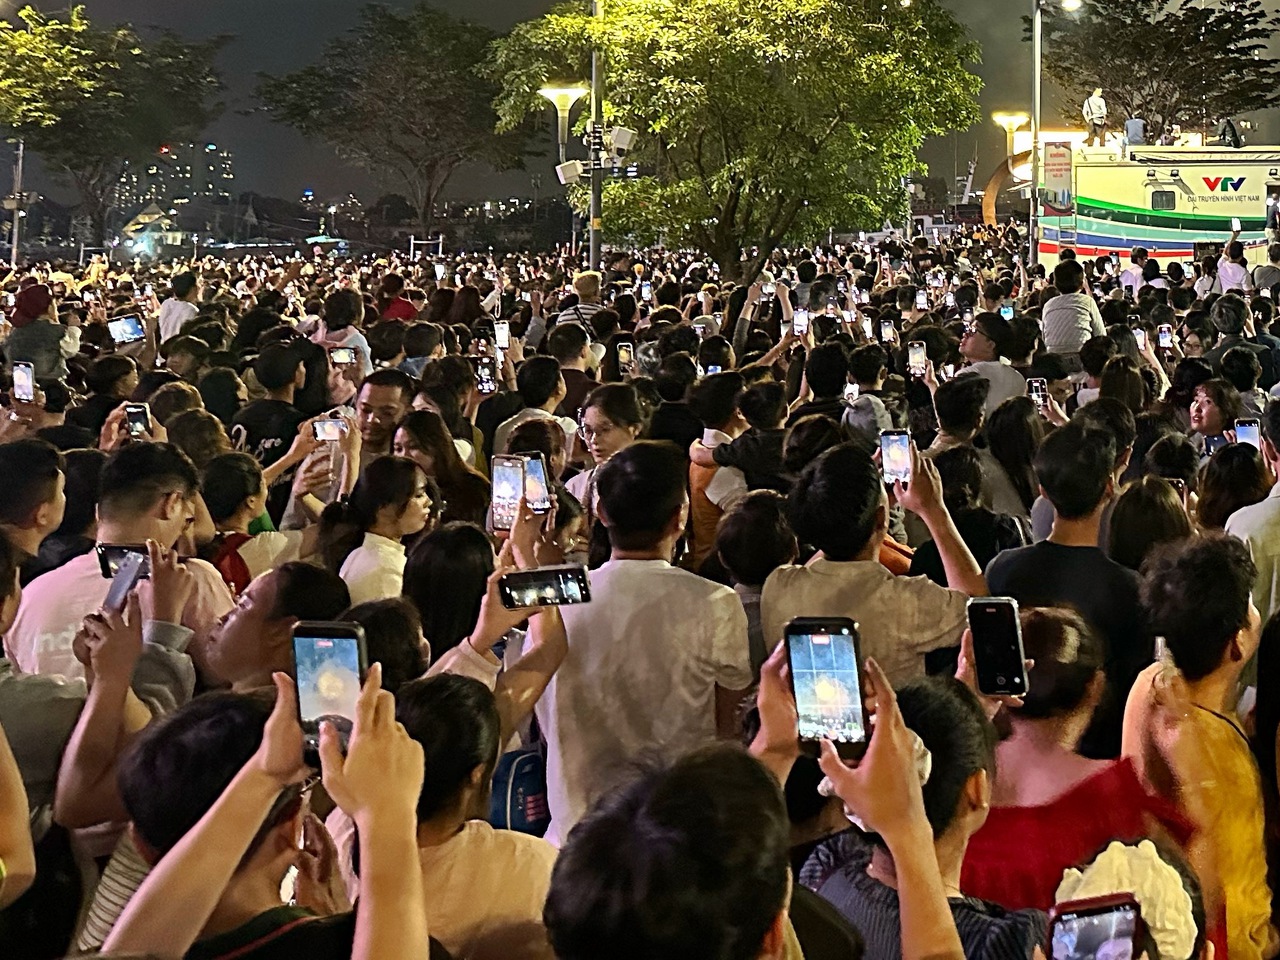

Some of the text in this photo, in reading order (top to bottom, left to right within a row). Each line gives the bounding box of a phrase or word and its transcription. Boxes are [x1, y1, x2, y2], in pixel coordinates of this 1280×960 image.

[1202, 177, 1246, 192] VTV
[1198, 194, 1220, 202] TRUYỀN
[1221, 194, 1234, 202] HÌNH
[1235, 195, 1247, 203] VIỆT
